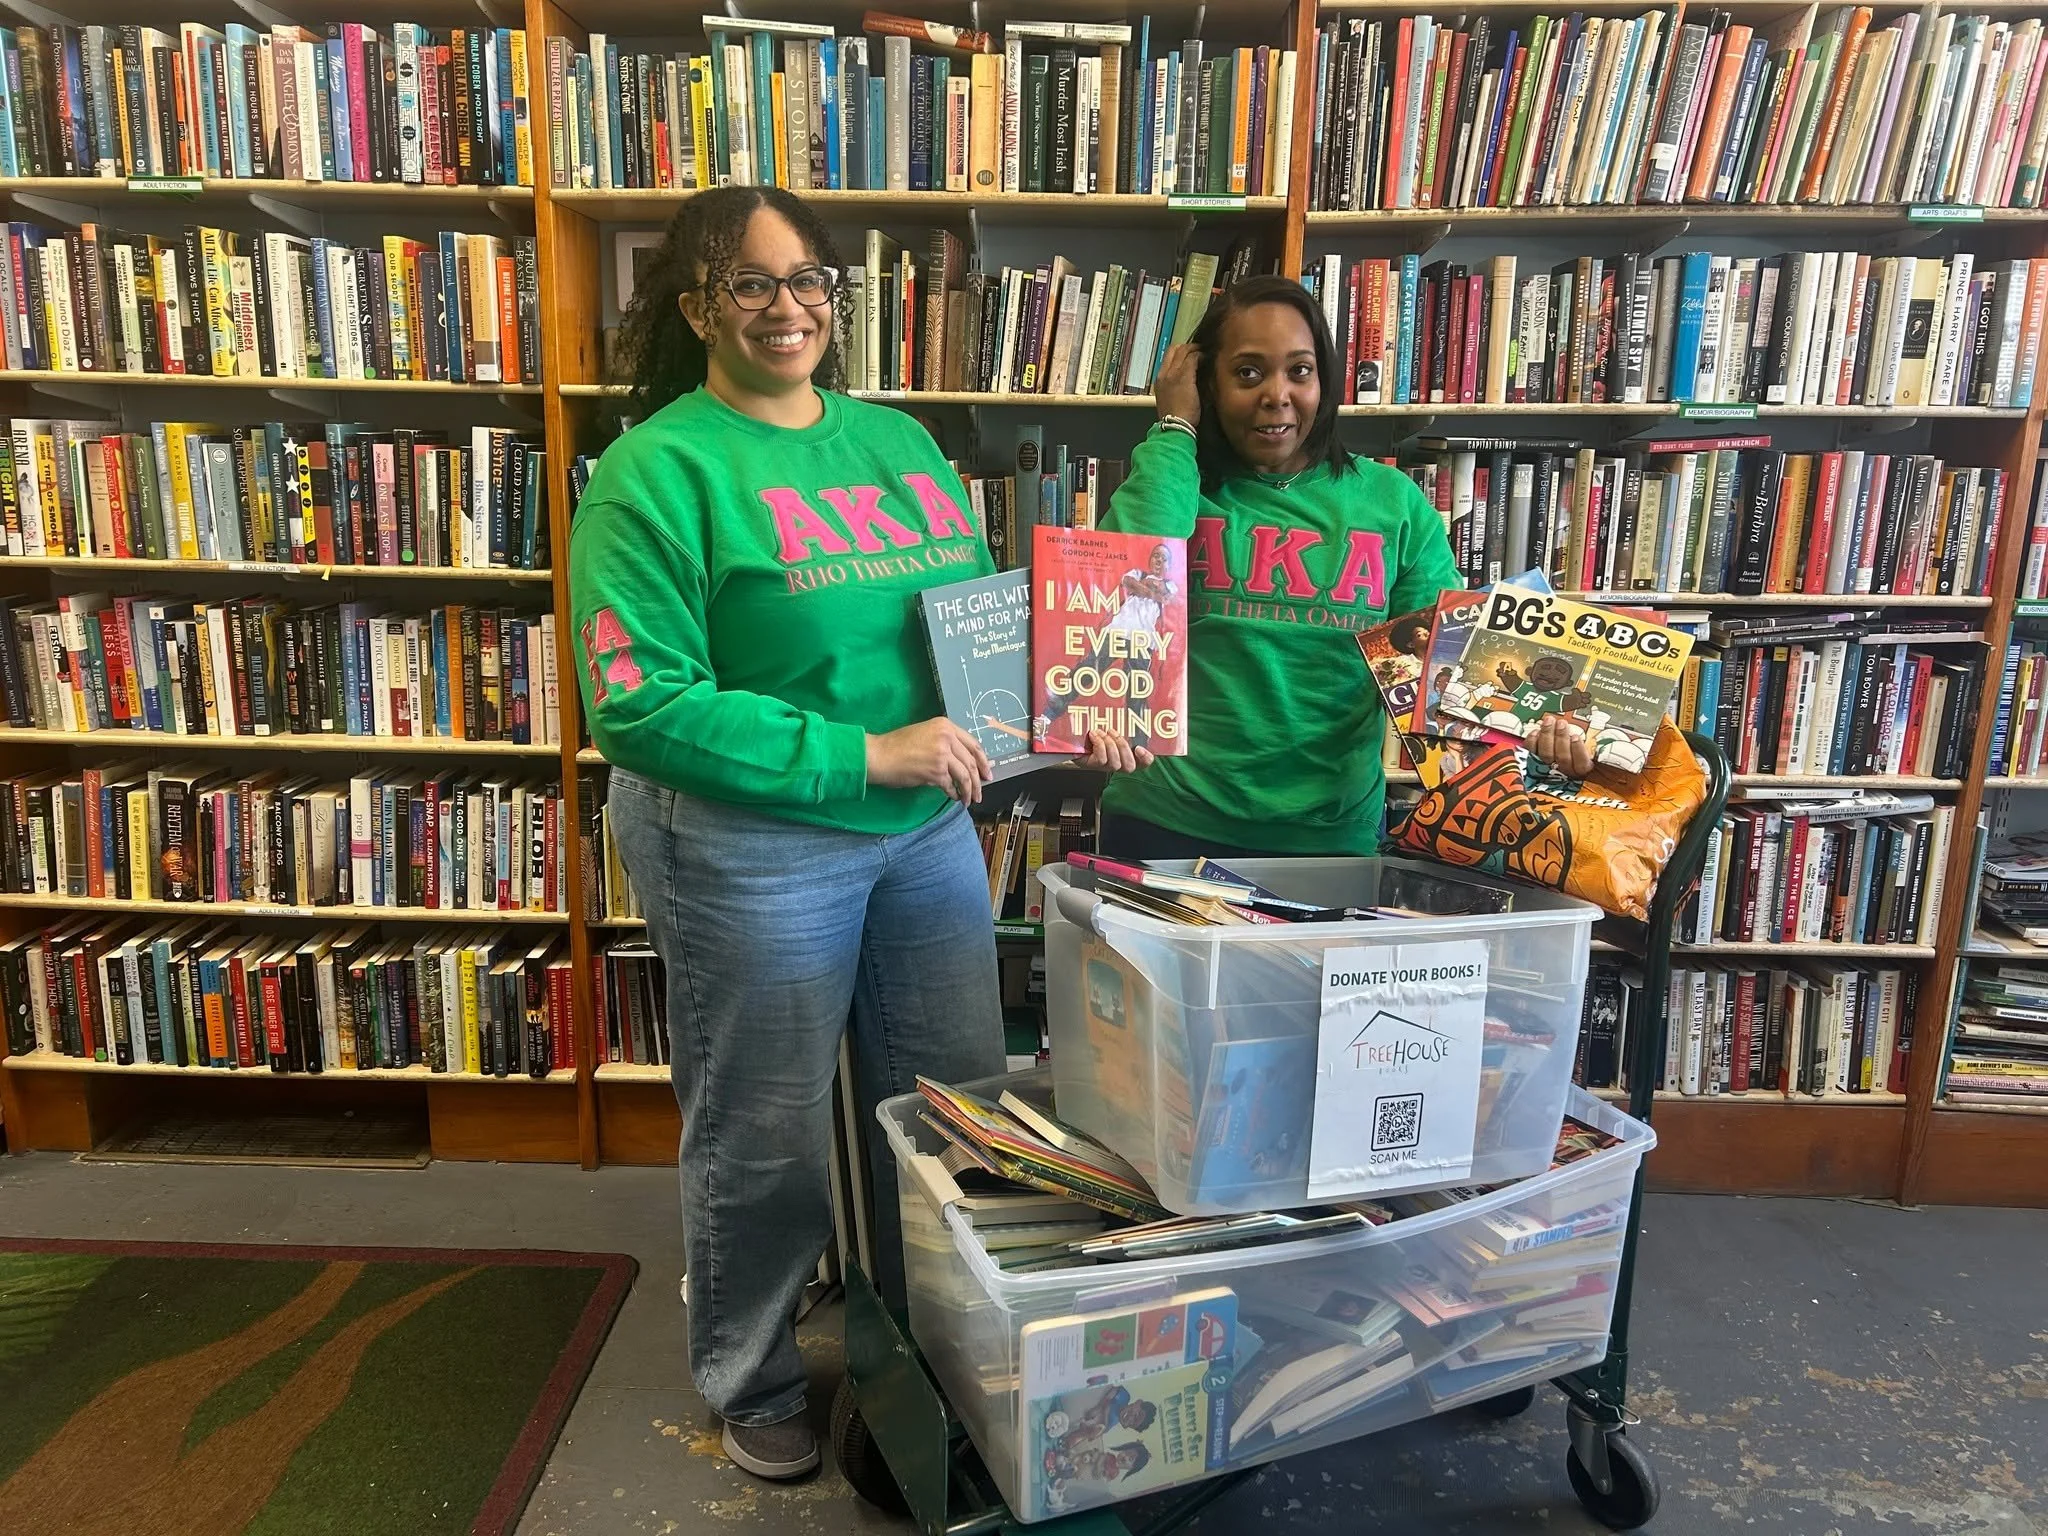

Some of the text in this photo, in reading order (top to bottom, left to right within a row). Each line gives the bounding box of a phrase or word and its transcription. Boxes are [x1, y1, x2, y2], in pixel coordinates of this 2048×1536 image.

[1668, 36, 1705, 135] MODERN ART
[250, 89, 258, 120] HOURS
[454, 51, 471, 167] HARLAN COBEN WIN
[791, 80, 807, 159] STORY
[1056, 67, 1070, 173] Murder Most Irish
[253, 122, 260, 133] IN
[253, 134, 261, 161] PARIS
[204, 233, 222, 333] All That Life Can Afford
[1403, 257, 1414, 332] JIM CARREY
[233, 293, 244, 353] JEFFREY EUGENIDES
[240, 291, 254, 351] Middlesex
[1627, 294, 1648, 373] ATOMIC SPY
[1941, 261, 1969, 385] PRINCE HARRY SPARE
[1980, 308, 1991, 329] GOT
[1975, 330, 1987, 355] THIS
[13, 430, 29, 466] ARENA
[1538, 460, 1550, 516] Tony Bennett
[379, 483, 391, 552] ONE LAST STOP
[757, 473, 976, 565] AKA
[1750, 496, 1768, 544] Barbra
[1850, 491, 1869, 569] THE WORLD WALK
[1047, 536, 1108, 549] DERRICK BARNES
[1062, 548, 1095, 559] GORDON
[1105, 552, 1128, 561] JAMES
[785, 545, 977, 594] RHO THETA OMEG
[1188, 517, 1387, 608] AKA
[934, 584, 1031, 621] THE GIRL WIT
[1046, 580, 1121, 615] I AM
[1220, 598, 1297, 623] THETA
[945, 605, 1032, 639] A MIND FOR MA
[1440, 610, 1448, 625] I
[1487, 593, 1566, 638] BG's
[36, 637, 45, 662] LITTLE
[115, 603, 131, 666] OUTLAWED
[973, 625, 1017, 645] The Story of
[991, 640, 1027, 656] Montague
[1065, 625, 1174, 660] EVERY
[1567, 636, 1675, 674] Tackling Football and Life
[39, 665, 49, 681] LIES
[1045, 665, 1154, 699] GOOD
[1595, 673, 1648, 694] Brandon Graham
[1520, 691, 1548, 711] 55
[1601, 684, 1622, 696] Lesley
[1622, 690, 1634, 699] Van
[1068, 705, 1179, 739] THING
[1625, 705, 1636, 713] Mr.
[1636, 709, 1648, 718] Tom
[355, 813, 363, 837] prep
[456, 834, 464, 861] ONES
[1787, 853, 1802, 921] BURN THE ICE
[42, 953, 56, 1008] BRAD THOR
[1330, 971, 1387, 987] DONATE
[1390, 968, 1427, 984] YOUR
[1431, 966, 1474, 981] BOOKS
[264, 984, 280, 1049] ROSE UNDER FIRE
[1369, 1149, 1417, 1165] SCAN ME
[1211, 1376, 1226, 1387] 2
